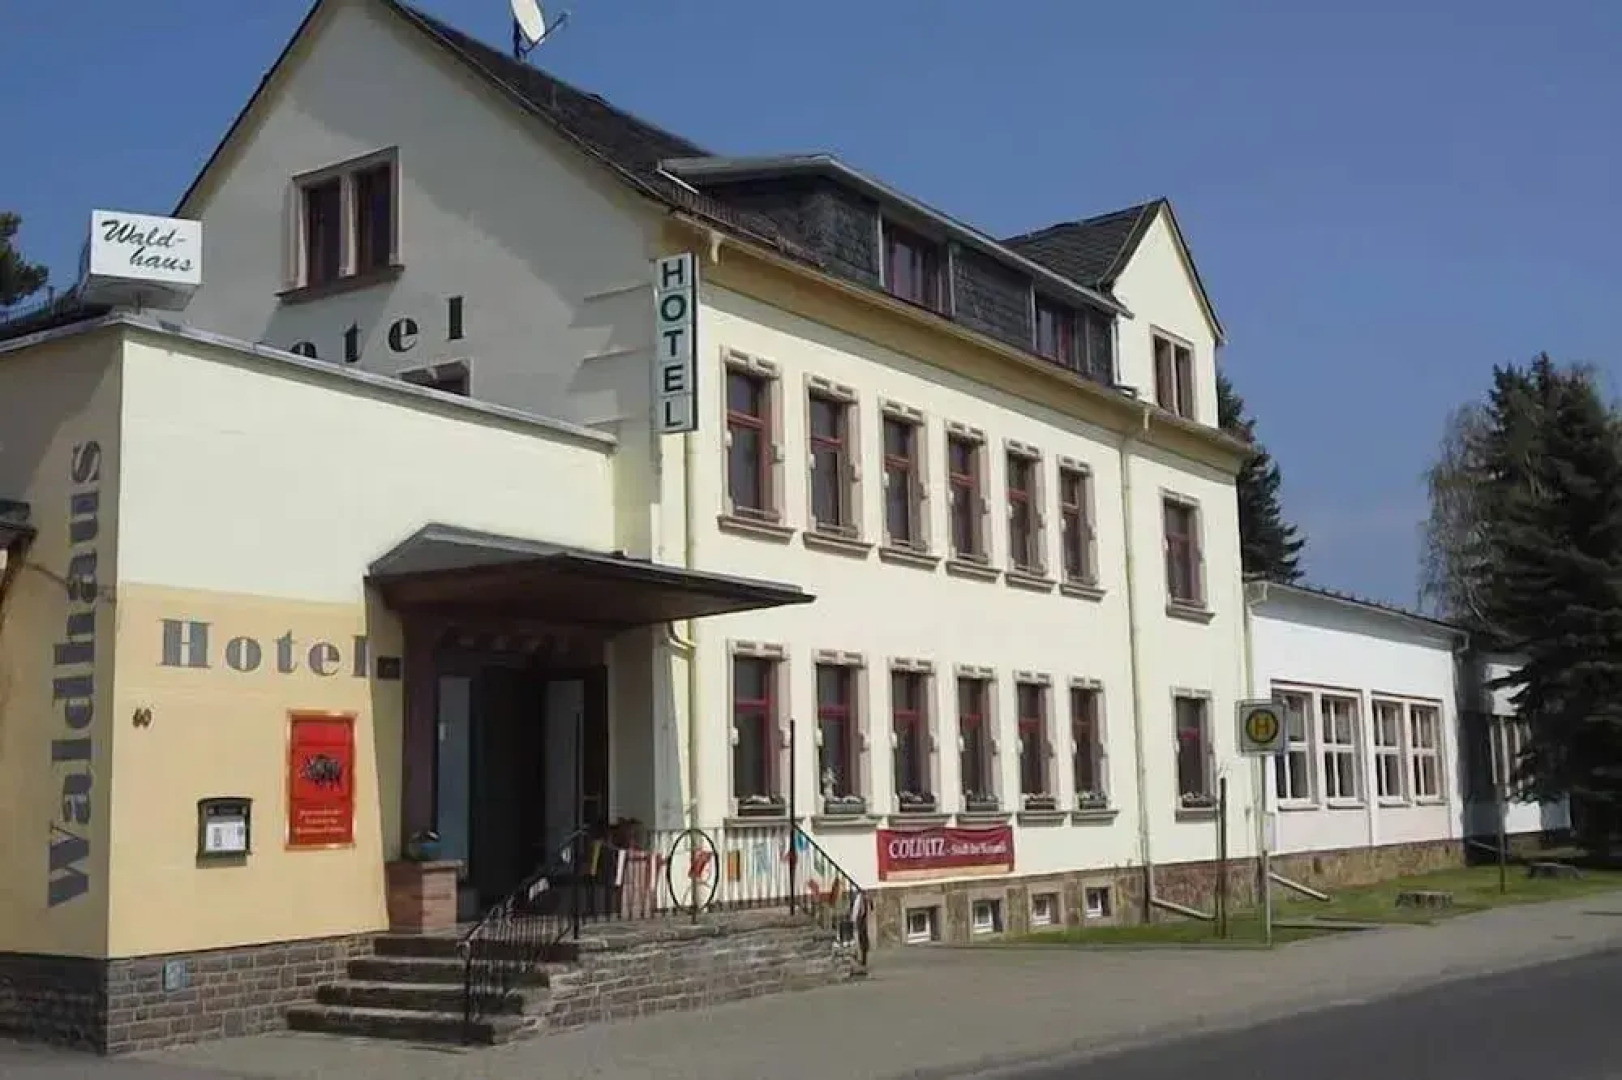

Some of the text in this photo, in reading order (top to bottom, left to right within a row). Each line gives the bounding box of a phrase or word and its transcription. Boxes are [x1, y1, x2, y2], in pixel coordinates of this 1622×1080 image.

[102, 219, 186, 248] Wald-
[129, 245, 193, 272] haus
[660, 258, 687, 428] HOTEL
[156, 618, 366, 677] Hotel
[45, 440, 102, 908] Waldhaus
[1255, 718, 1269, 736] H
